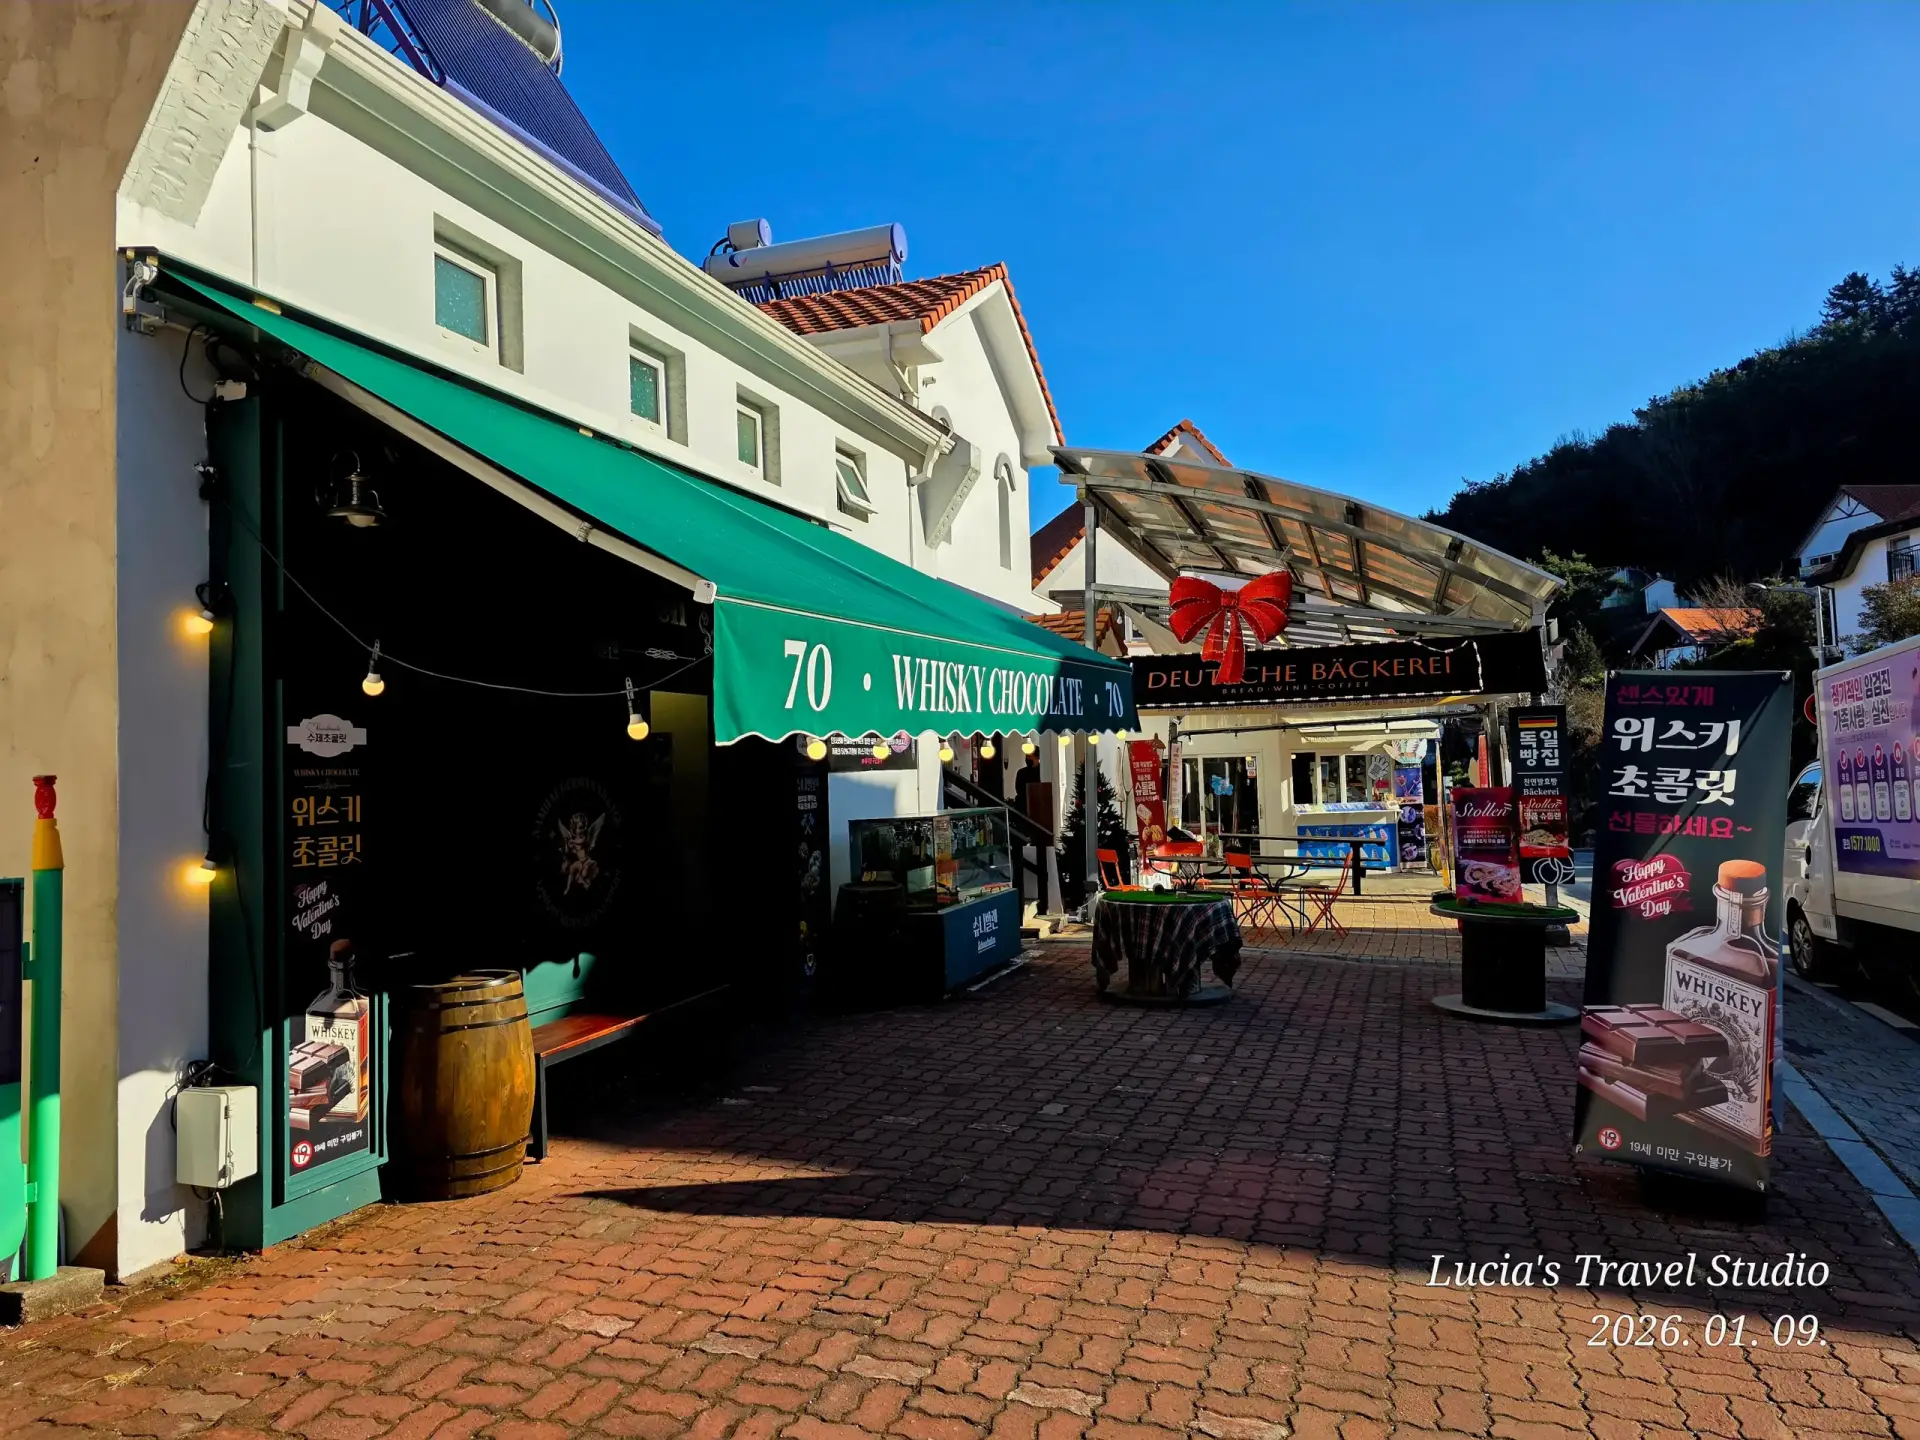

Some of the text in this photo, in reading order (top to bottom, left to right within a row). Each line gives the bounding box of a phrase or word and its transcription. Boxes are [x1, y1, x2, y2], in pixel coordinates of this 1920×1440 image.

[783, 639, 1125, 718] 70 WHISKY CHOCOLATE 70
[1148, 656, 1451, 688] DEUTCHE BÄCKEREI
[1222, 681, 1369, 694] BREAD WINE COFFEE
[1616, 684, 1715, 706] 센스있게
[1831, 668, 1892, 707] 정기적인 암검진
[1833, 698, 1907, 732] 가족사랑의 실천입니다
[306, 733, 347, 743] 수제초콜릿
[1520, 730, 1559, 748] 독일
[1612, 717, 1741, 756] 위스키
[1520, 749, 1560, 767] 빵집
[1135, 781, 1157, 796] 슈톨렌
[1523, 788, 1560, 796] Bäckerei
[1608, 765, 1737, 806] 초콜릿
[291, 795, 361, 827] 위스키
[1455, 802, 1512, 818] Stollen
[1523, 798, 1562, 809] Stollen
[291, 833, 363, 869] 초콜릿
[1621, 859, 1666, 883] Happy
[297, 880, 328, 909] Happy
[1613, 875, 1685, 906] Valentine's
[292, 893, 341, 932] Valentine's
[1640, 899, 1672, 918] Day
[310, 917, 333, 940] Day
[1675, 970, 1763, 1018] WHISKEY
[311, 1025, 356, 1041] WHISKEY
[1629, 1141, 1733, 1172] 19세 미만 구입불가
